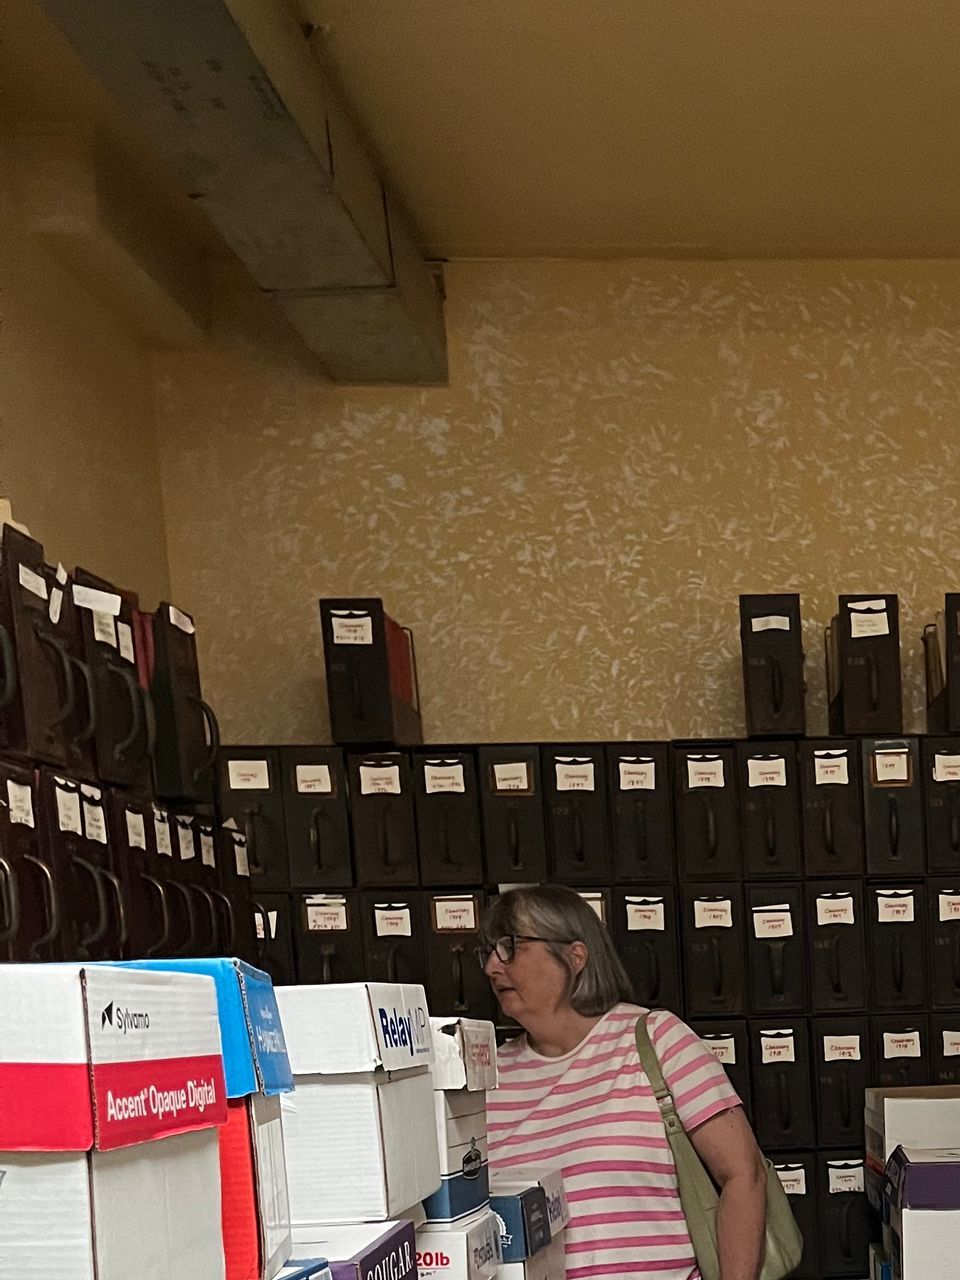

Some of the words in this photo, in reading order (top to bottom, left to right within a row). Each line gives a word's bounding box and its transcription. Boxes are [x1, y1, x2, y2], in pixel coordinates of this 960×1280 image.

[116, 1007, 149, 1035] Sylvamo
[379, 1007, 414, 1056] Relay
[149, 1084, 187, 1120] Opaque
[187, 1077, 216, 1113] Digital
